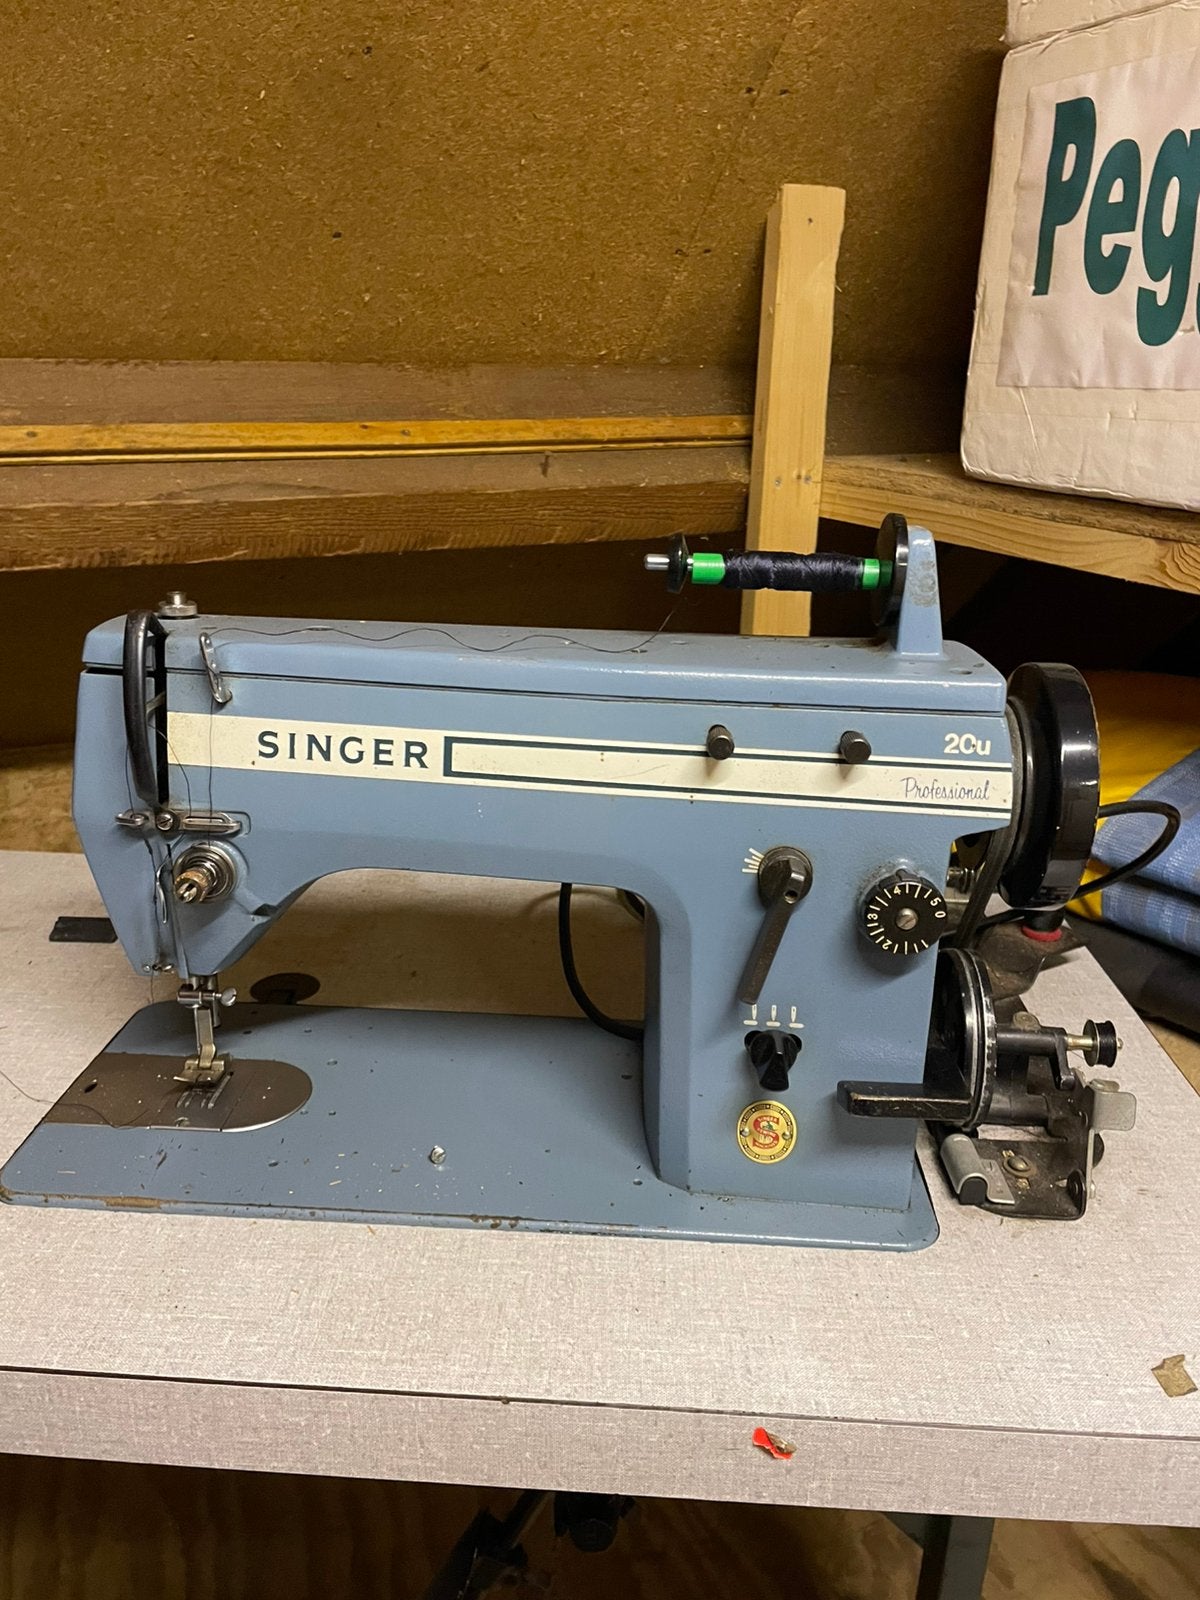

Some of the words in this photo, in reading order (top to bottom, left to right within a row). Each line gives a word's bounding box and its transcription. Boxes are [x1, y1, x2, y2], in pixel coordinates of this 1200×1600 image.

[258, 731, 429, 769] SINGER
[943, 733, 991, 755] 20u
[900, 776, 990, 800] Professional
[893, 885, 902, 895] 4
[930, 897, 941, 907] 5
[882, 939, 892, 950] 2
